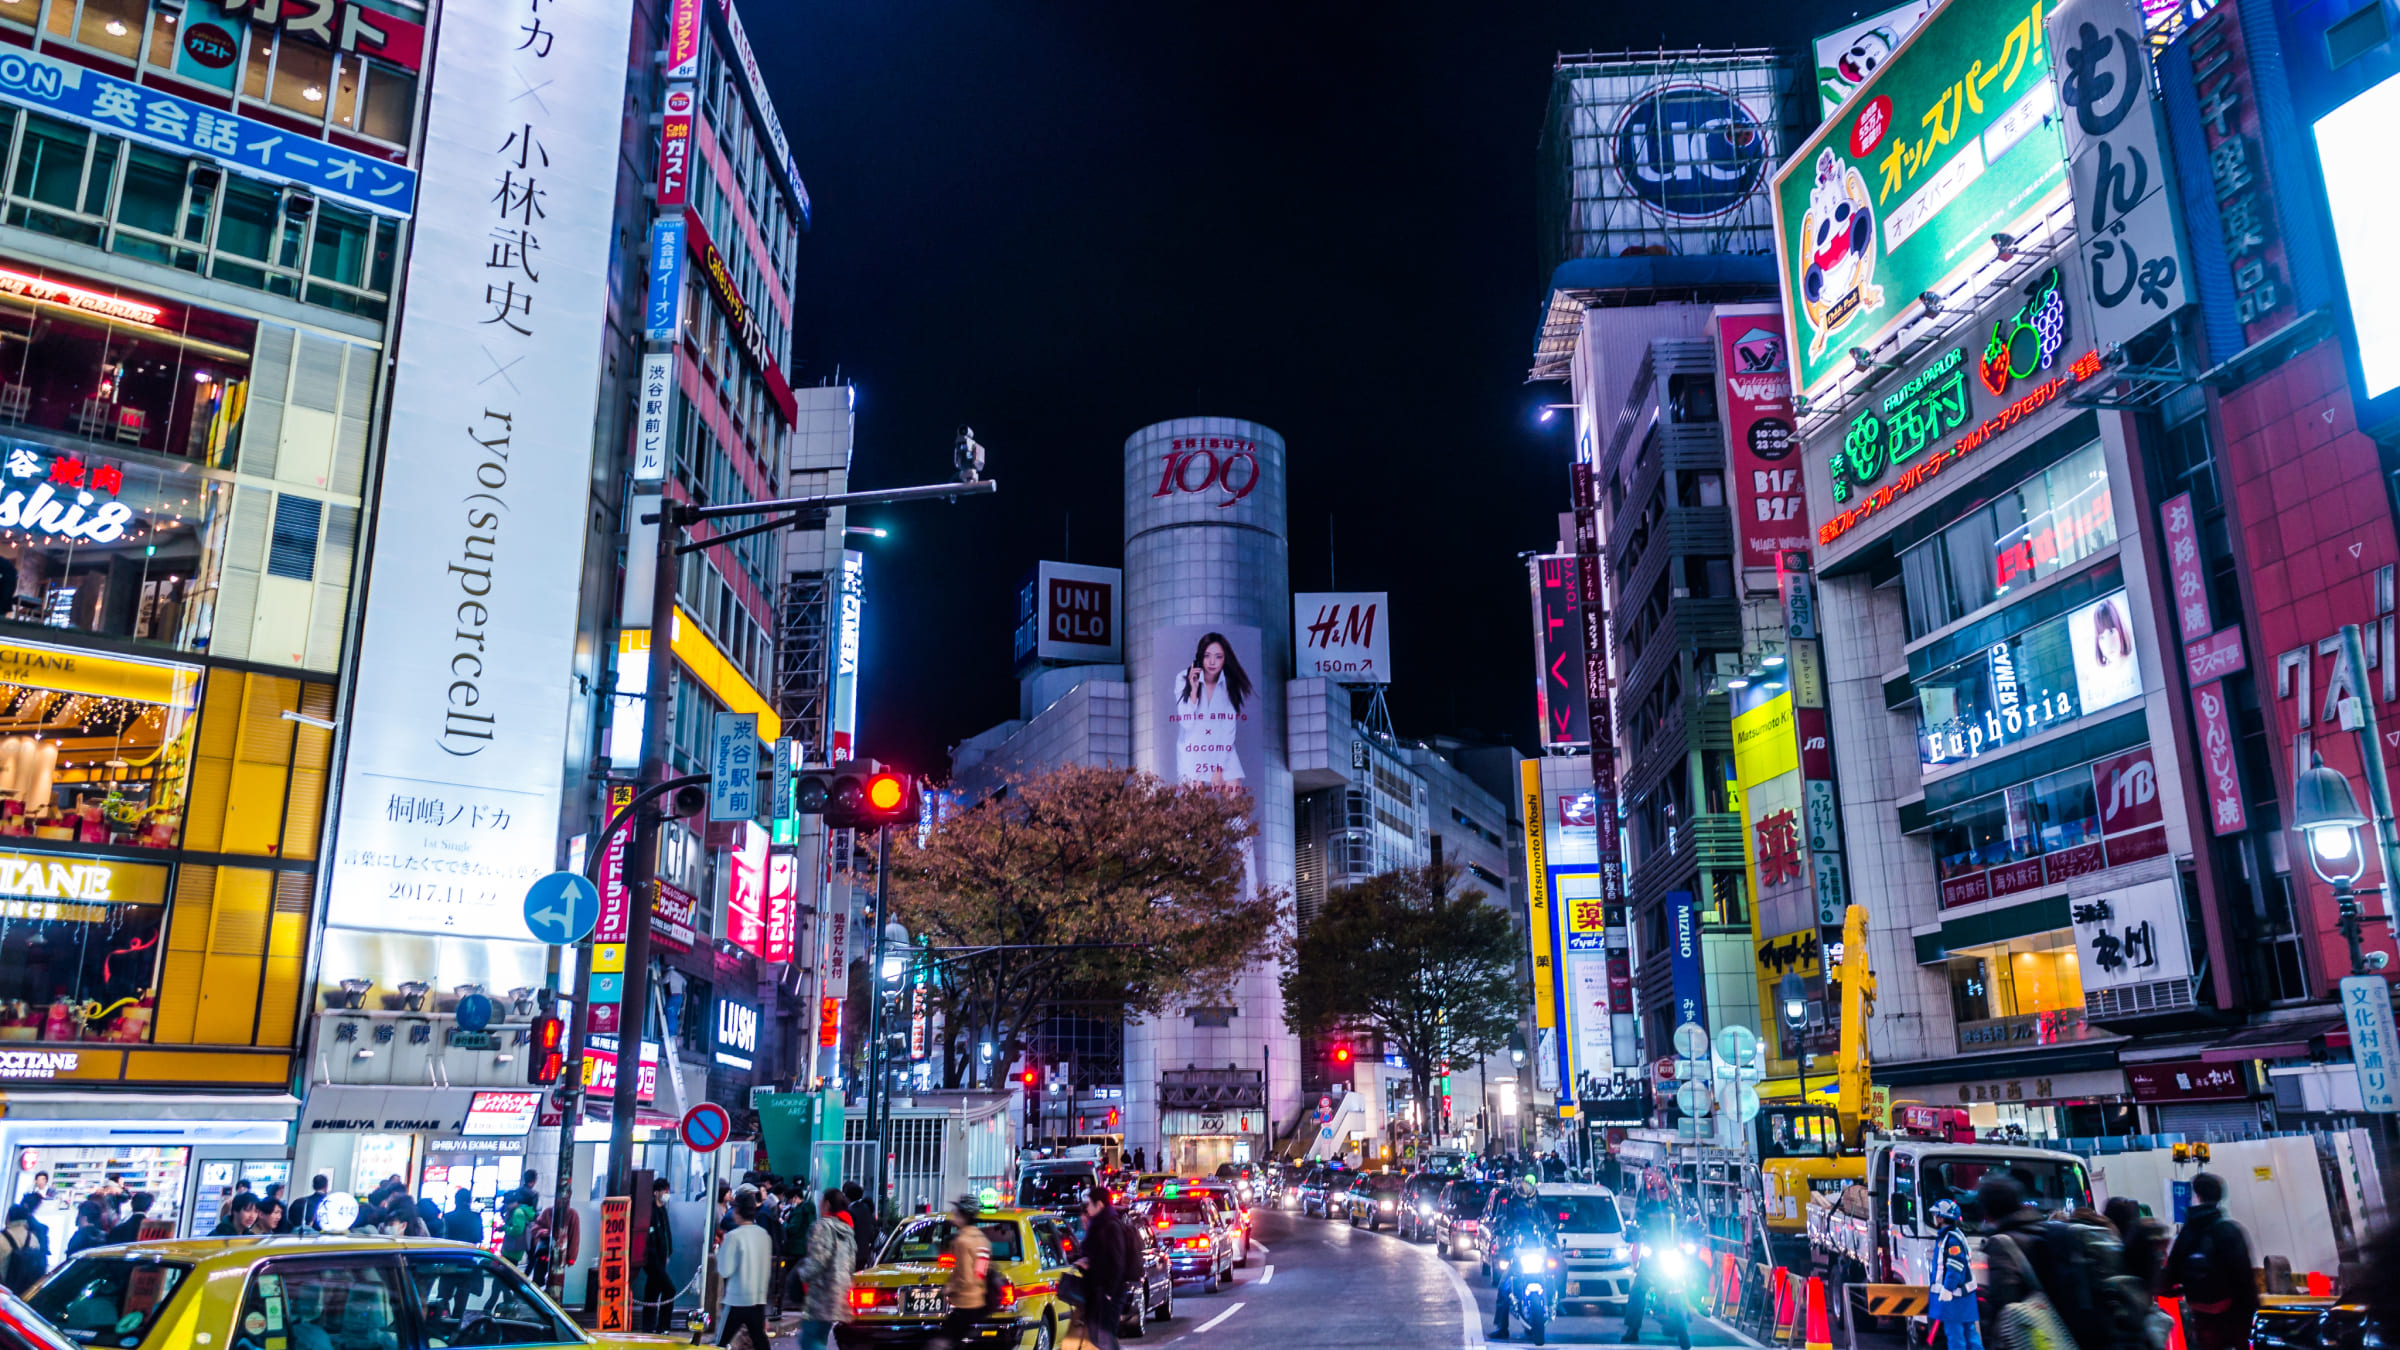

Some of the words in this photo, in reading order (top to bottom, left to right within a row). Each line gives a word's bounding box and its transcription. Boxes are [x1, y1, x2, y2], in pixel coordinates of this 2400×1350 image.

[678, 66, 694, 76] 8F
[92, 81, 405, 196] 英会話イーオン
[666, 123, 688, 132] Café
[664, 138, 687, 194] ガスト
[2062, 21, 2178, 310] もんじゃ
[655, 231, 676, 327] 英会話イーオン
[653, 328, 668, 339] 6F
[1883, 347, 1963, 414] FRUITS&PARLOR
[641, 365, 666, 468] 渋谷駅前ビル
[1756, 429, 1788, 439] 10:00
[1887, 370, 1969, 465] 西村
[1172, 438, 1257, 452] SHIBUYA
[1152, 450, 1260, 509] 109
[1754, 469, 1797, 493] B1F
[1829, 453, 1847, 503] 渋谷
[0, 479, 132, 543] shi8
[1756, 497, 1801, 522] B2F
[1566, 557, 1577, 612] TOKYO
[2169, 505, 2207, 633] お好み焼
[1056, 586, 1101, 611] UNI
[1056, 613, 1104, 638] QLO
[1307, 604, 1376, 648] H&M
[1314, 660, 1357, 673] 150m
[1169, 712, 1204, 722] namie
[1209, 712, 1248, 721] amuro
[1736, 715, 1781, 745] Matsumoto
[1927, 689, 2072, 765] Euphoria
[719, 735, 731, 779] Shibuya
[1185, 744, 1232, 752] docomo
[1803, 736, 1826, 751] JTB
[2199, 690, 2240, 827] もんじゃ焼
[730, 720, 753, 812] 渋谷駅前
[777, 741, 788, 817] スクランブル式
[1195, 763, 1224, 773] 25th
[2105, 759, 2157, 822] JTB
[386, 793, 511, 830] 桐嶋ノドカ
[1527, 794, 1540, 838] KiYoshi
[1810, 799, 1822, 836] パーラー
[1821, 794, 1834, 830] フルーツ
[1755, 807, 1804, 887] 薬
[602, 828, 628, 933] サンドラッグ
[1532, 839, 1544, 909] Matsumoto
[1818, 871, 1831, 909] フルーツ
[1946, 881, 1987, 903] 国内旅行
[1995, 866, 2040, 891] 海外旅行
[0, 900, 58, 919] NCE
[832, 912, 846, 979] 処方せん受付
[1677, 904, 1692, 959] MIZUHO
[718, 999, 757, 1052] LUSH
[2350, 986, 2386, 1091] 文化村通り
[771, 1098, 808, 1106] SMOKING
[787, 1107, 807, 1116] AREA
[312, 1119, 375, 1129] SHIBUYA
[384, 1119, 441, 1129] EKIMAE
[1200, 1119, 1224, 1134] 109
[432, 1140, 466, 1151] SHIBUYA
[468, 1140, 498, 1151] EKIMAE
[605, 1219, 625, 1233] 200
[605, 1246, 623, 1302] 工事中
